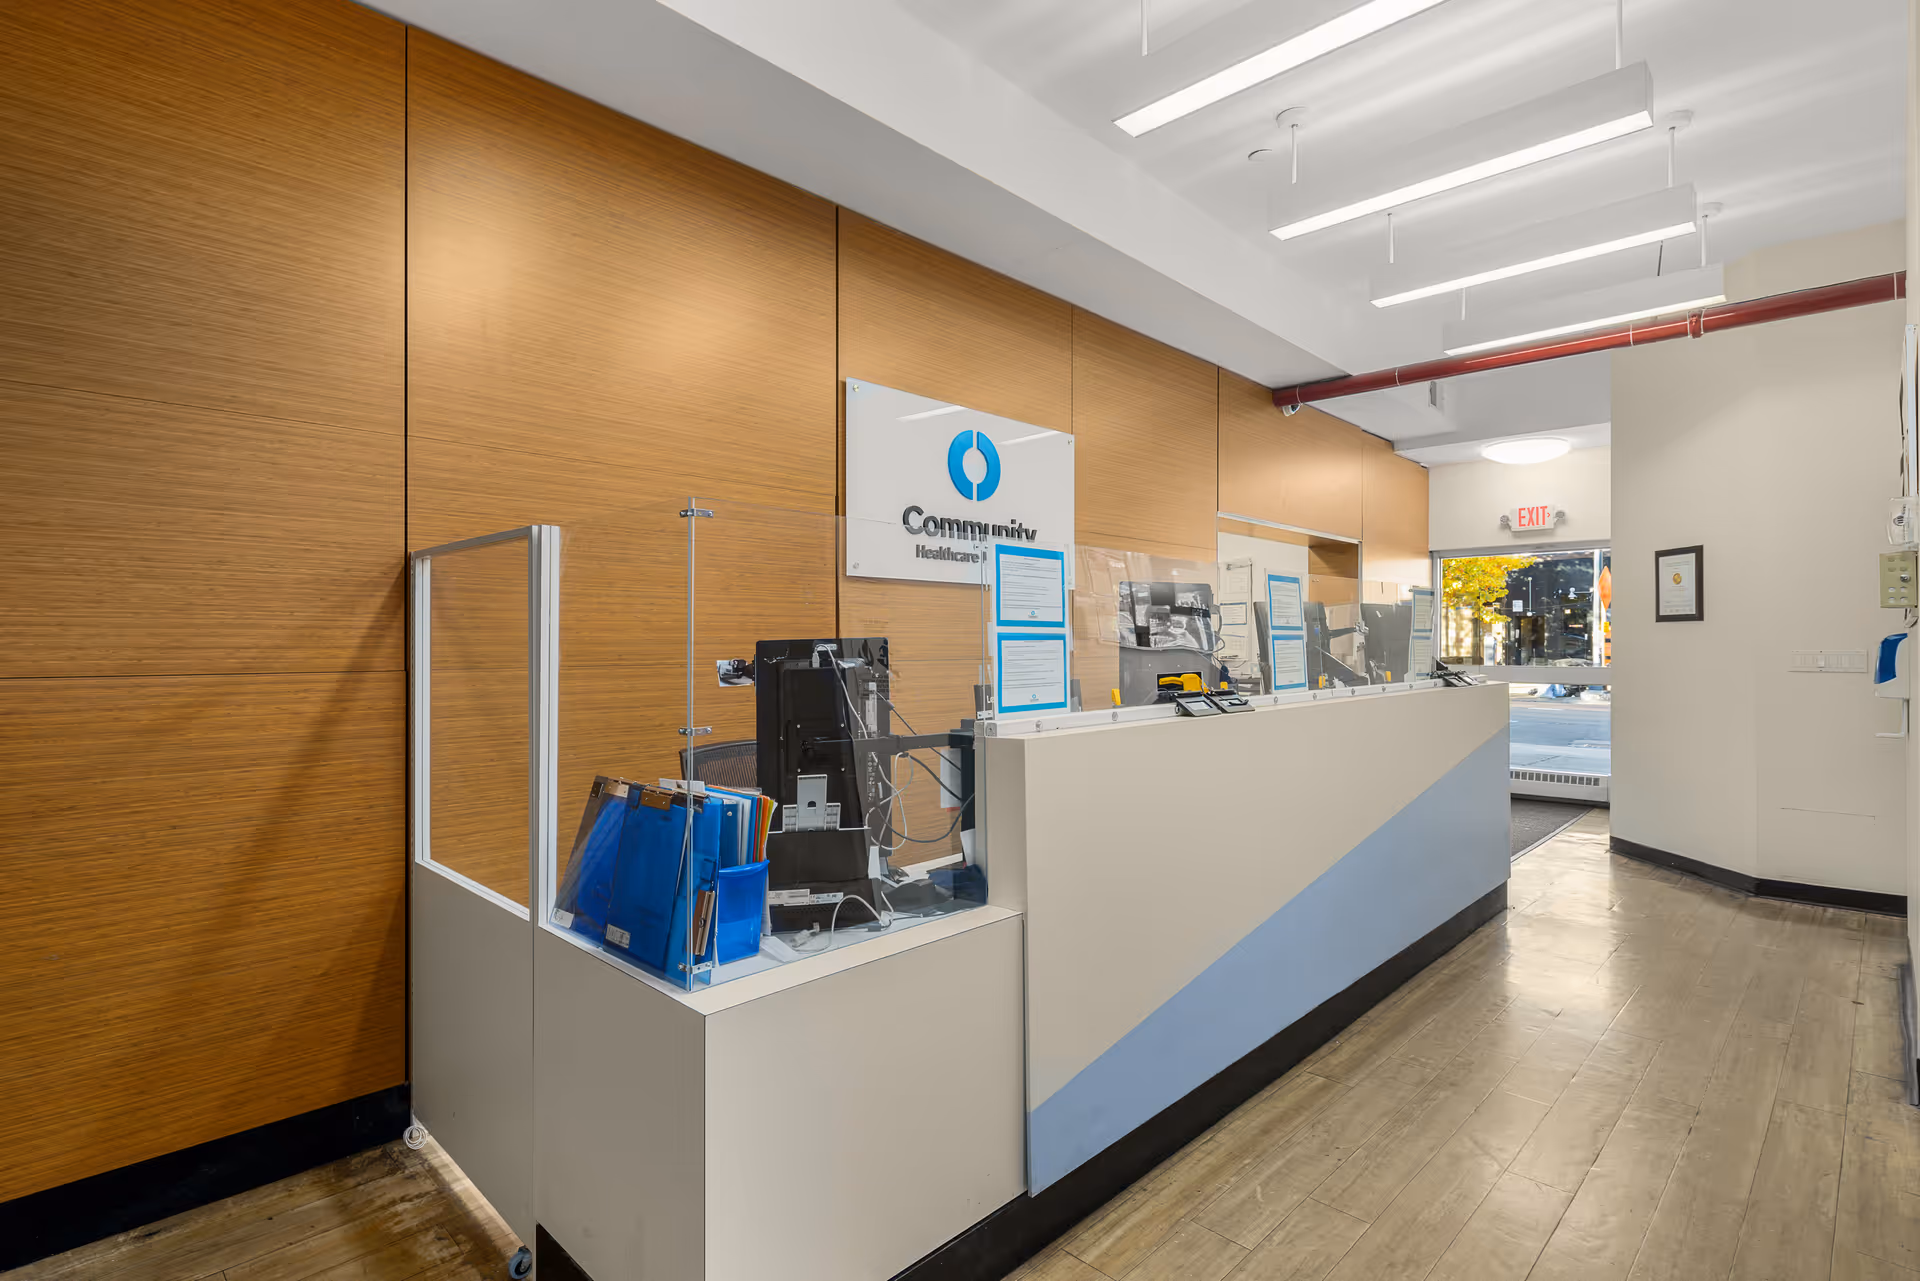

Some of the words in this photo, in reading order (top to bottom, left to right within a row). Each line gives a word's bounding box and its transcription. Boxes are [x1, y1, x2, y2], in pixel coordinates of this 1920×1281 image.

[903, 505, 1037, 542] Community
[1518, 506, 1548, 527] EXIT
[915, 544, 980, 563] Healthcare
